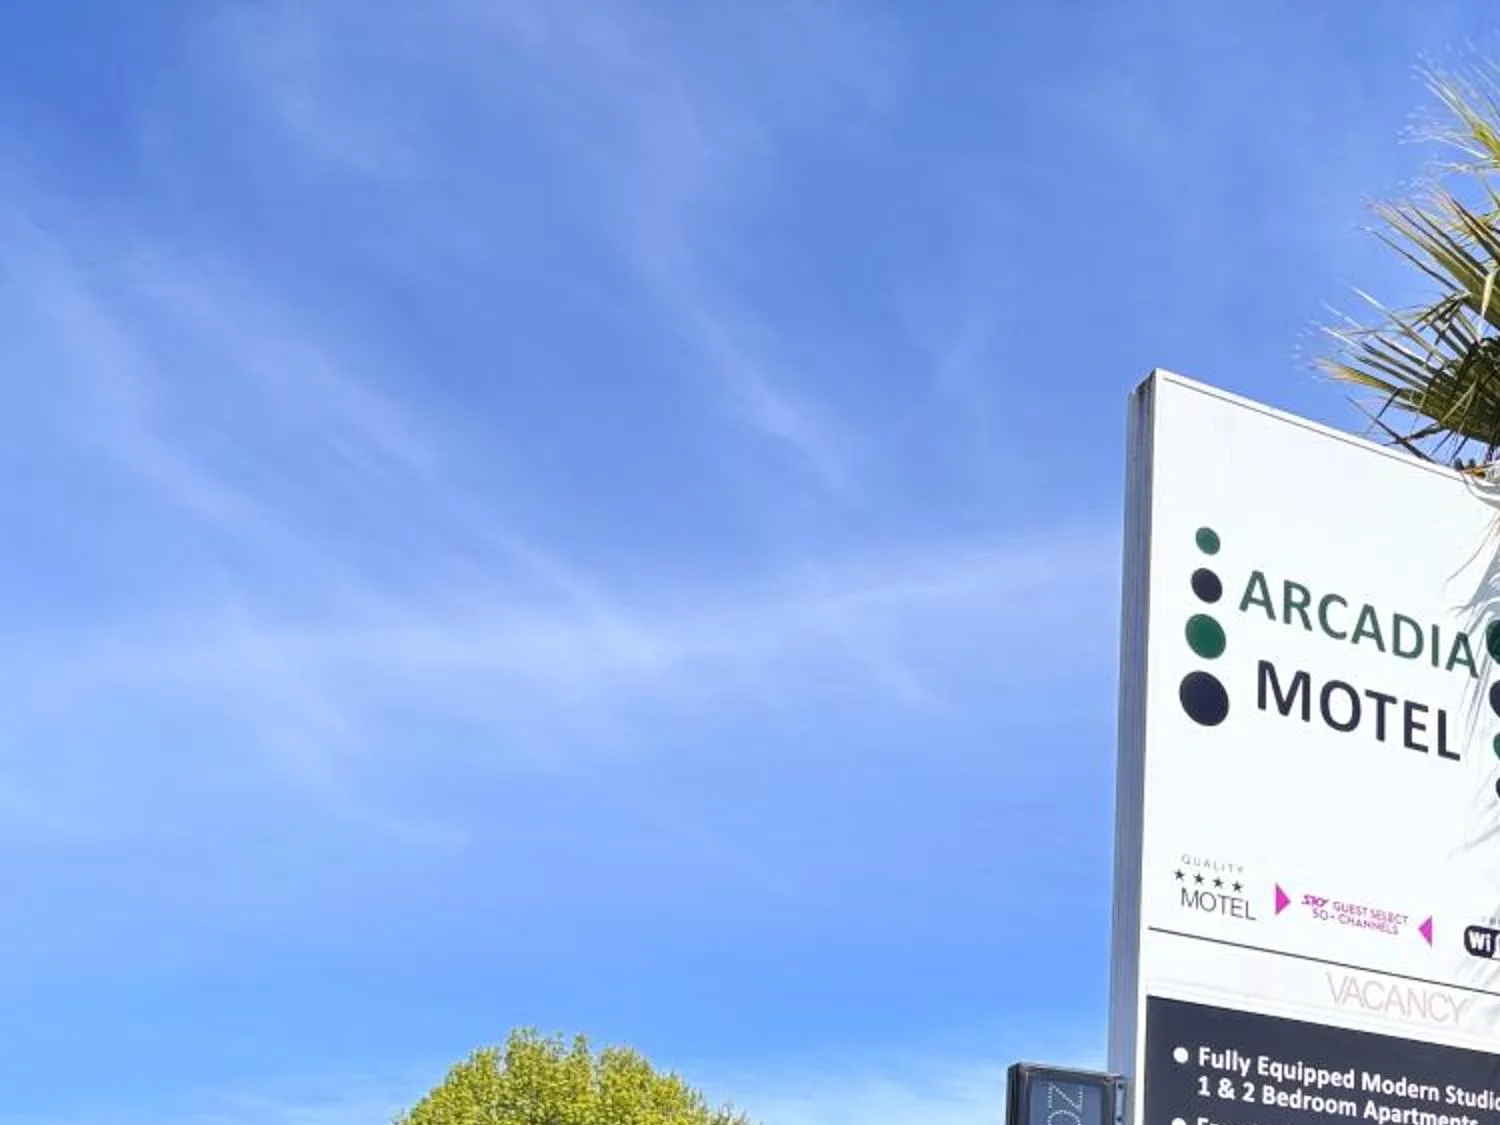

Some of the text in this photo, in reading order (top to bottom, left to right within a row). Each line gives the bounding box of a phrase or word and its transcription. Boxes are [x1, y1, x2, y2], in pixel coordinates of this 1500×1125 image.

[1239, 570, 1480, 679] ARCADIA
[1256, 659, 1462, 762] MOTEL
[1181, 853, 1244, 874] QUALITY
[1181, 887, 1258, 921] MOTEL
[1332, 901, 1368, 917] GUEST
[1370, 908, 1409, 926] SELECT
[1338, 913, 1399, 936] CHANNELS
[1325, 971, 1469, 1026] VACANCY
[1199, 1046, 1251, 1078] Fully
[1257, 1055, 1355, 1089] Equipped
[1361, 1071, 1440, 1102] Modern
[1198, 1075, 1211, 1097] 1
[1217, 1078, 1235, 1100] &
[1242, 1081, 1255, 1103] 2
[1262, 1084, 1357, 1117] Bedroom
